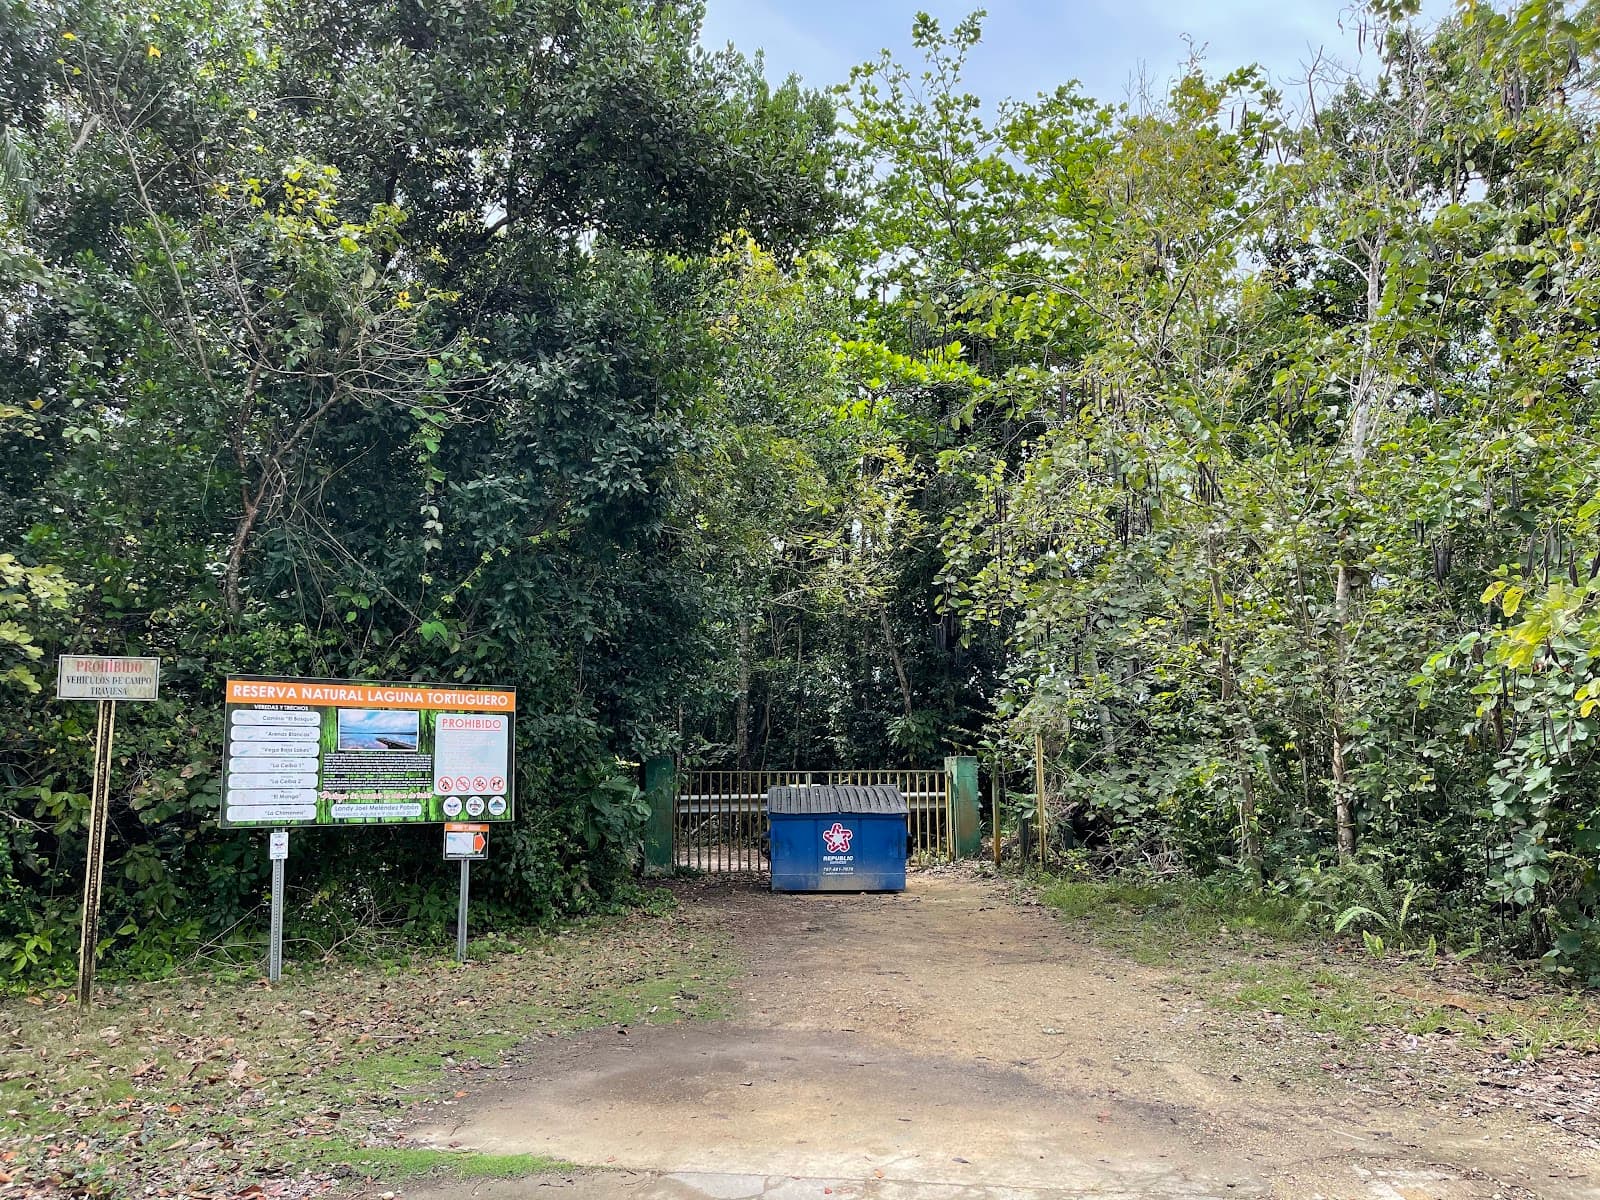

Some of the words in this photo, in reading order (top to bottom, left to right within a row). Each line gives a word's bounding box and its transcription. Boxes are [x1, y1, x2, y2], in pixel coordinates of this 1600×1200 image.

[76, 660, 143, 673] PROHIBIDO
[112, 676, 123, 685] DE
[125, 676, 152, 685] CAMPO
[90, 686, 128, 696] TRAVIESA
[233, 685, 297, 699] RESERVA
[302, 687, 363, 701] NATURAL
[368, 690, 424, 704] LAGUNA
[427, 692, 508, 706] TORTUGUERO
[442, 718, 501, 729] PROHIBIDO
